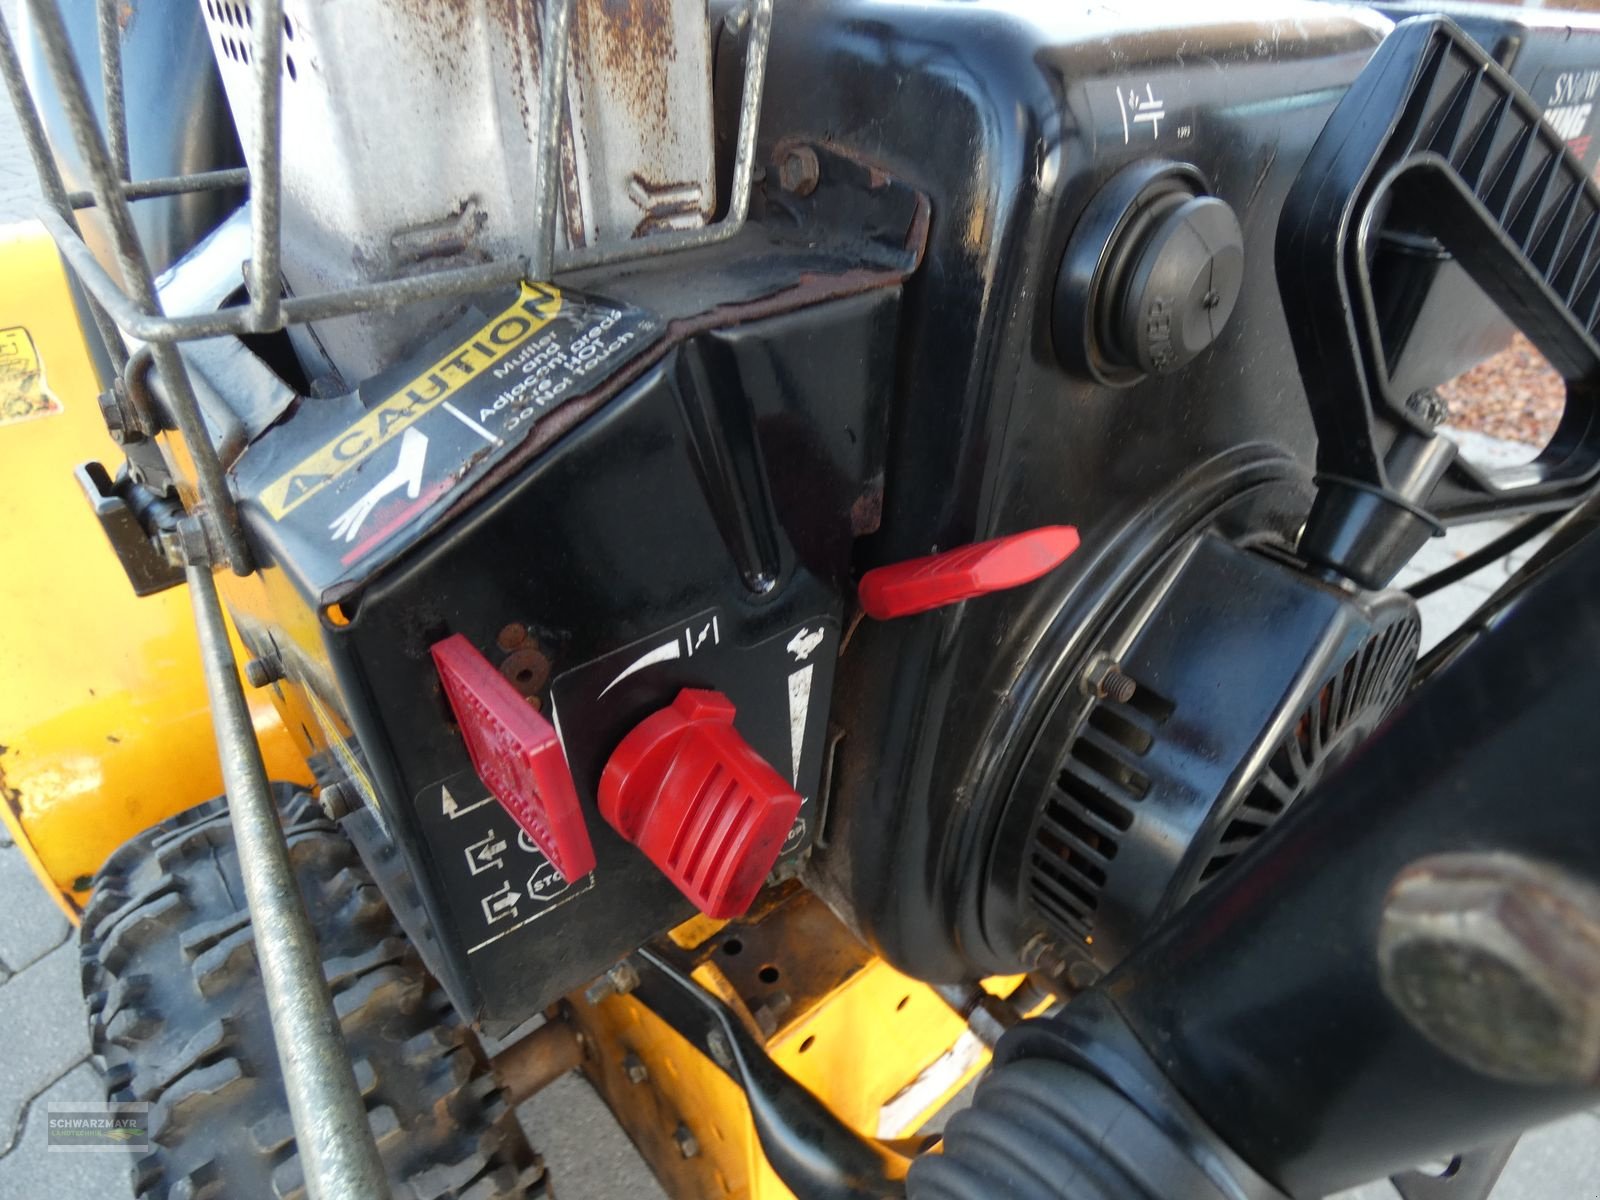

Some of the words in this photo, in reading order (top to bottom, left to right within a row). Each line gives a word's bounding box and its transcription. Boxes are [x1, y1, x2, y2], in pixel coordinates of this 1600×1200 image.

[333, 283, 558, 461] CAUTION
[480, 350, 567, 422] Adjacent
[570, 309, 622, 354] areas
[522, 341, 560, 374] and
[535, 376, 573, 406] Not
[573, 332, 634, 376] Touch
[564, 338, 604, 371] HOT
[534, 871, 562, 892] STO
